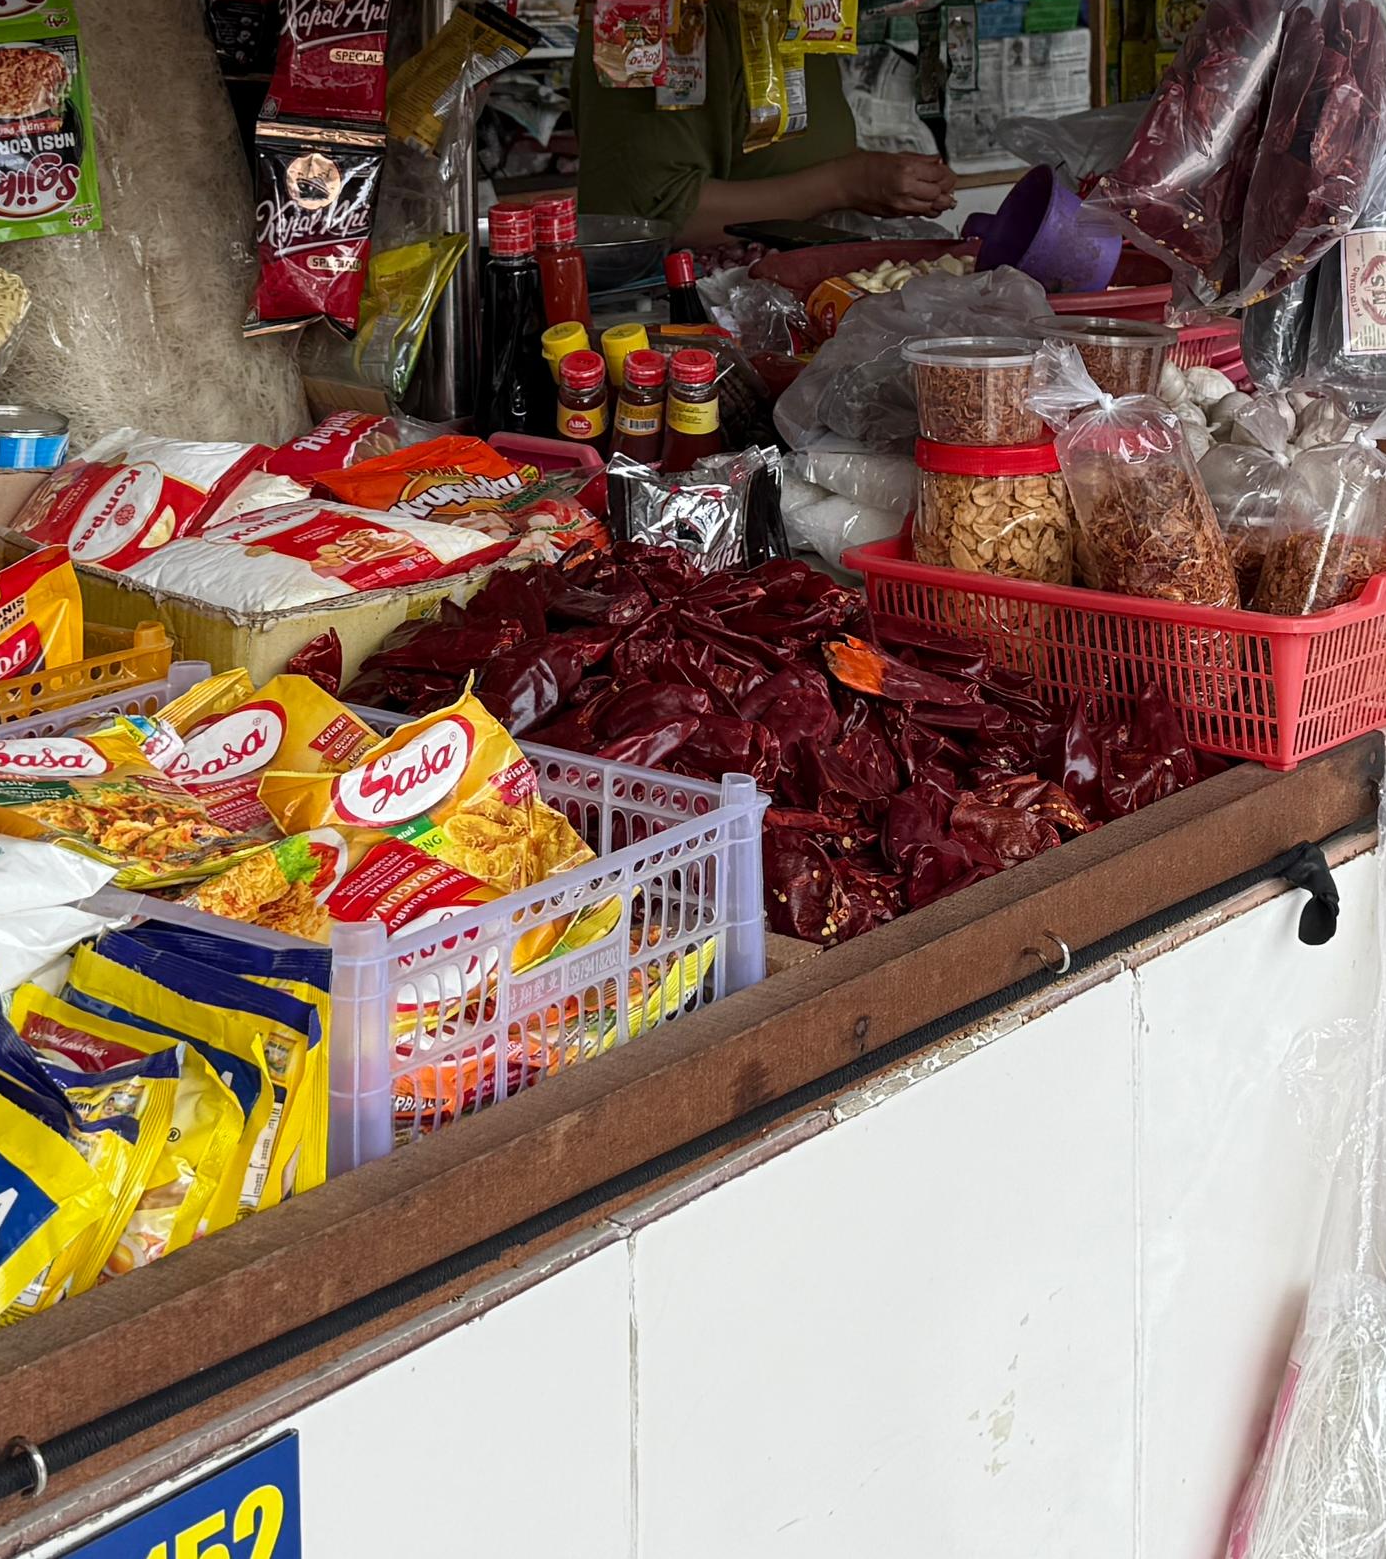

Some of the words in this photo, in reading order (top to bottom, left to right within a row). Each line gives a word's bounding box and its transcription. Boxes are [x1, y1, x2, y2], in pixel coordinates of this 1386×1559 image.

[334, 50, 382, 64] SPECIAL
[46, 131, 76, 150] NASI
[256, 197, 319, 244] Kapal
[320, 200, 370, 239] Api
[567, 419, 592, 430] ABC
[72, 468, 143, 553] Kompas
[317, 716, 350, 748] Krispi
[166, 720, 270, 784] Sasa
[358, 743, 455, 814] Sasa
[498, 760, 533, 787] Krispi
[364, 860, 417, 900] ORIGINAL
[388, 892, 429, 929] BUMBU
